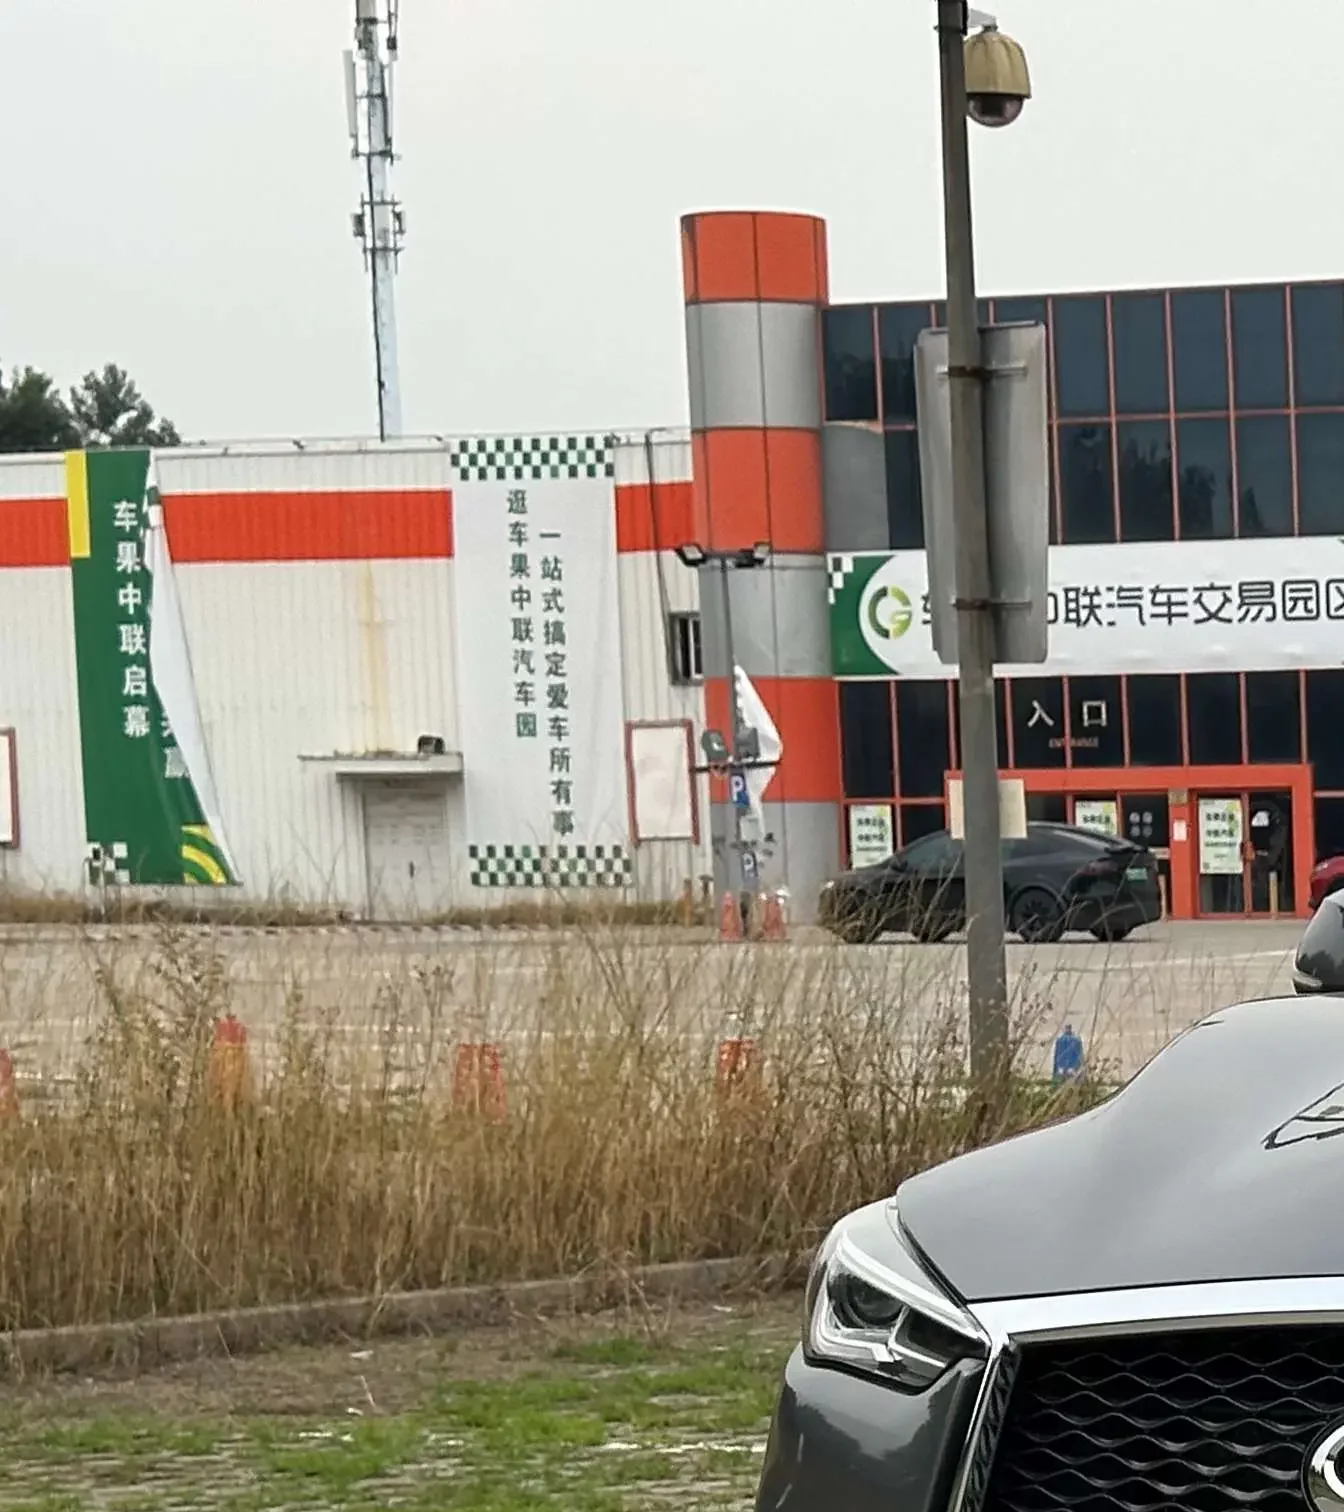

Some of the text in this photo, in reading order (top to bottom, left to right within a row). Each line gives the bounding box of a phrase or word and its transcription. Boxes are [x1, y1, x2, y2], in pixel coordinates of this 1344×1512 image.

[112, 500, 151, 739] 车果中联启幕
[506, 488, 538, 738] 逛车果中联汽车园
[538, 531, 575, 838] 一站式搞定爱车所有事
[1026, 699, 1109, 729] 入口
